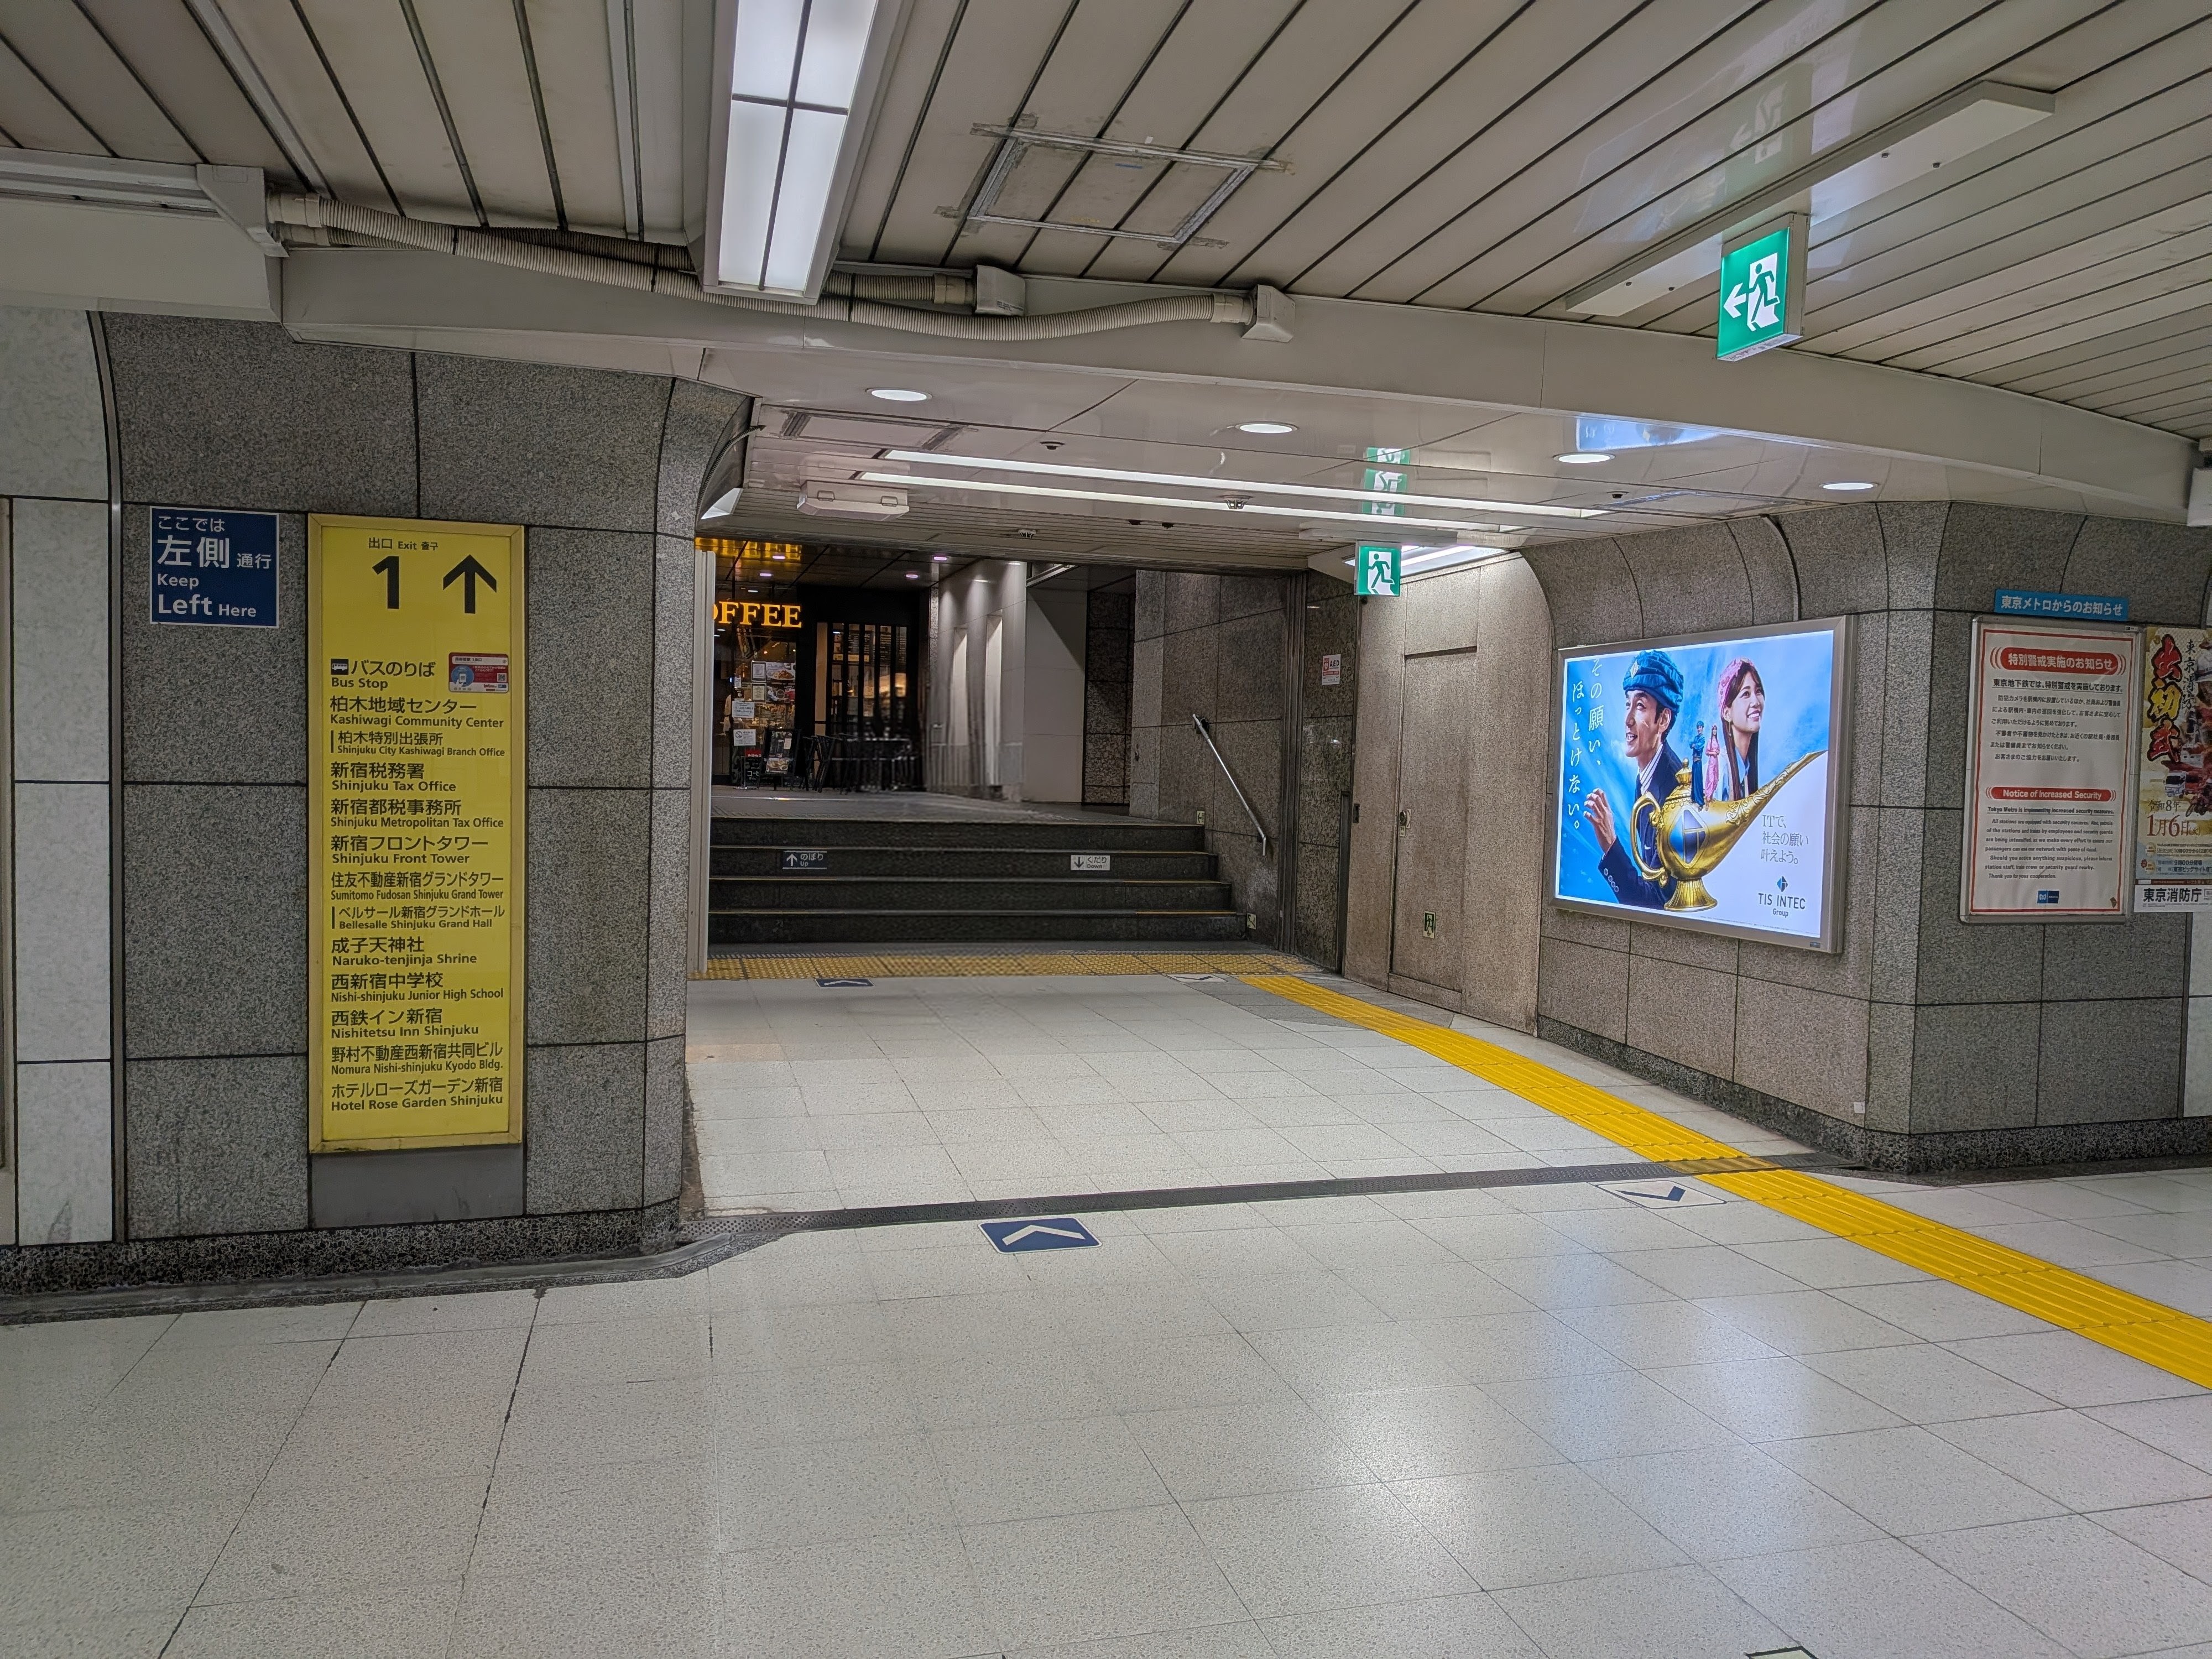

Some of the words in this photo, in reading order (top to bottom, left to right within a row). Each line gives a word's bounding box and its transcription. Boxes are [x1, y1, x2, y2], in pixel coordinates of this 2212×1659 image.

[158, 517, 225, 532] ここでは
[369, 538, 392, 549] 出口
[398, 541, 417, 550] Exit
[157, 535, 229, 568] 左側
[237, 553, 272, 569] 通行
[158, 574, 199, 589] Keep
[372, 556, 399, 609] 1
[159, 594, 212, 615] Left
[218, 604, 256, 617] Here
[2001, 596, 2122, 615] 東京メトロからのお知らせ
[351, 659, 436, 677] バスのりば
[2008, 653, 2112, 670] 特別警戒実施のお知らせ
[332, 677, 354, 687] Bus
[358, 678, 388, 690] Stop
[330, 696, 477, 714] 柏木地域センター
[1589, 659, 1604, 765] その願い、
[330, 714, 391, 727] Kashiwagi
[395, 716, 462, 729] Community
[466, 718, 504, 728] Center
[338, 731, 443, 745] 柏木特別出張所
[337, 746, 376, 755] Shinjuku
[379, 746, 396, 755] City
[399, 747, 444, 757] Kashiwagi
[447, 748, 476, 756] Branch
[479, 748, 505, 757] Office
[1568, 681, 1584, 829] ほっとけない。
[331, 762, 424, 779] 新宿税務署
[332, 780, 388, 792] Shinjuku
[393, 781, 414, 790] Tax
[418, 781, 456, 791] Office
[2074, 791, 2101, 800] Security
[331, 799, 461, 815] 新宿都税事務所
[2148, 800, 2181, 811] 令和8年
[331, 817, 377, 828] Shinjuku
[381, 818, 449, 830] Metropolitan
[453, 818, 469, 827] Tax
[473, 818, 503, 827] Office
[1762, 815, 1786, 828] ITで、
[331, 835, 488, 851] 新宿フロントタワー
[1763, 831, 1809, 847] 社会の願い
[332, 853, 388, 865] Shinjuku
[393, 853, 426, 863] Front
[431, 854, 469, 863] Tower
[1761, 849, 1798, 864] 叶えよう。
[331, 872, 503, 888] 住友不動産新宿グランドタワー
[331, 890, 374, 900] Sumitomo
[377, 890, 411, 899] Fudosan
[414, 889, 449, 901] Shinjuku
[452, 889, 476, 899] Grand
[478, 890, 503, 899] Tower
[1759, 893, 1772, 905] TIS
[1777, 895, 1806, 910] INTEC
[2143, 888, 2202, 902] 東京消防庁
[339, 905, 505, 919] ベルサール新宿グランドホール
[1773, 909, 1788, 918] Group
[391, 921, 435, 930] Shinjuku
[473, 919, 492, 927] Hall
[332, 937, 424, 953] 成子天神社
[332, 955, 432, 967] Naruko-tenjinja
[437, 954, 477, 964] Shrine
[331, 972, 443, 990] 西新宿中学校
[331, 992, 405, 1003] Nishi-shinjuku
[408, 991, 440, 1000] Junior
[443, 989, 467, 1001] High
[470, 988, 503, 999] School
[332, 1008, 442, 1026] 西鉄イン新宿
[332, 1028, 395, 1039] Nishitetsu
[400, 1026, 419, 1036] Inn
[424, 1024, 478, 1037] Shinjuku
[332, 1042, 503, 1063] 野村不動産西新宿共同ビル
[332, 1065, 371, 1074] Nomura
[374, 1062, 442, 1074] Nishi-shinjuku
[446, 1060, 476, 1073] Kyodo
[479, 1060, 503, 1071] Bldg.
[332, 1077, 503, 1099] ホテルローズガーデン新宿
[332, 1100, 364, 1111] Hotel
[369, 1100, 398, 1109] Rose
[402, 1097, 446, 1108] Garden
[451, 1095, 503, 1107] Shinjuku
